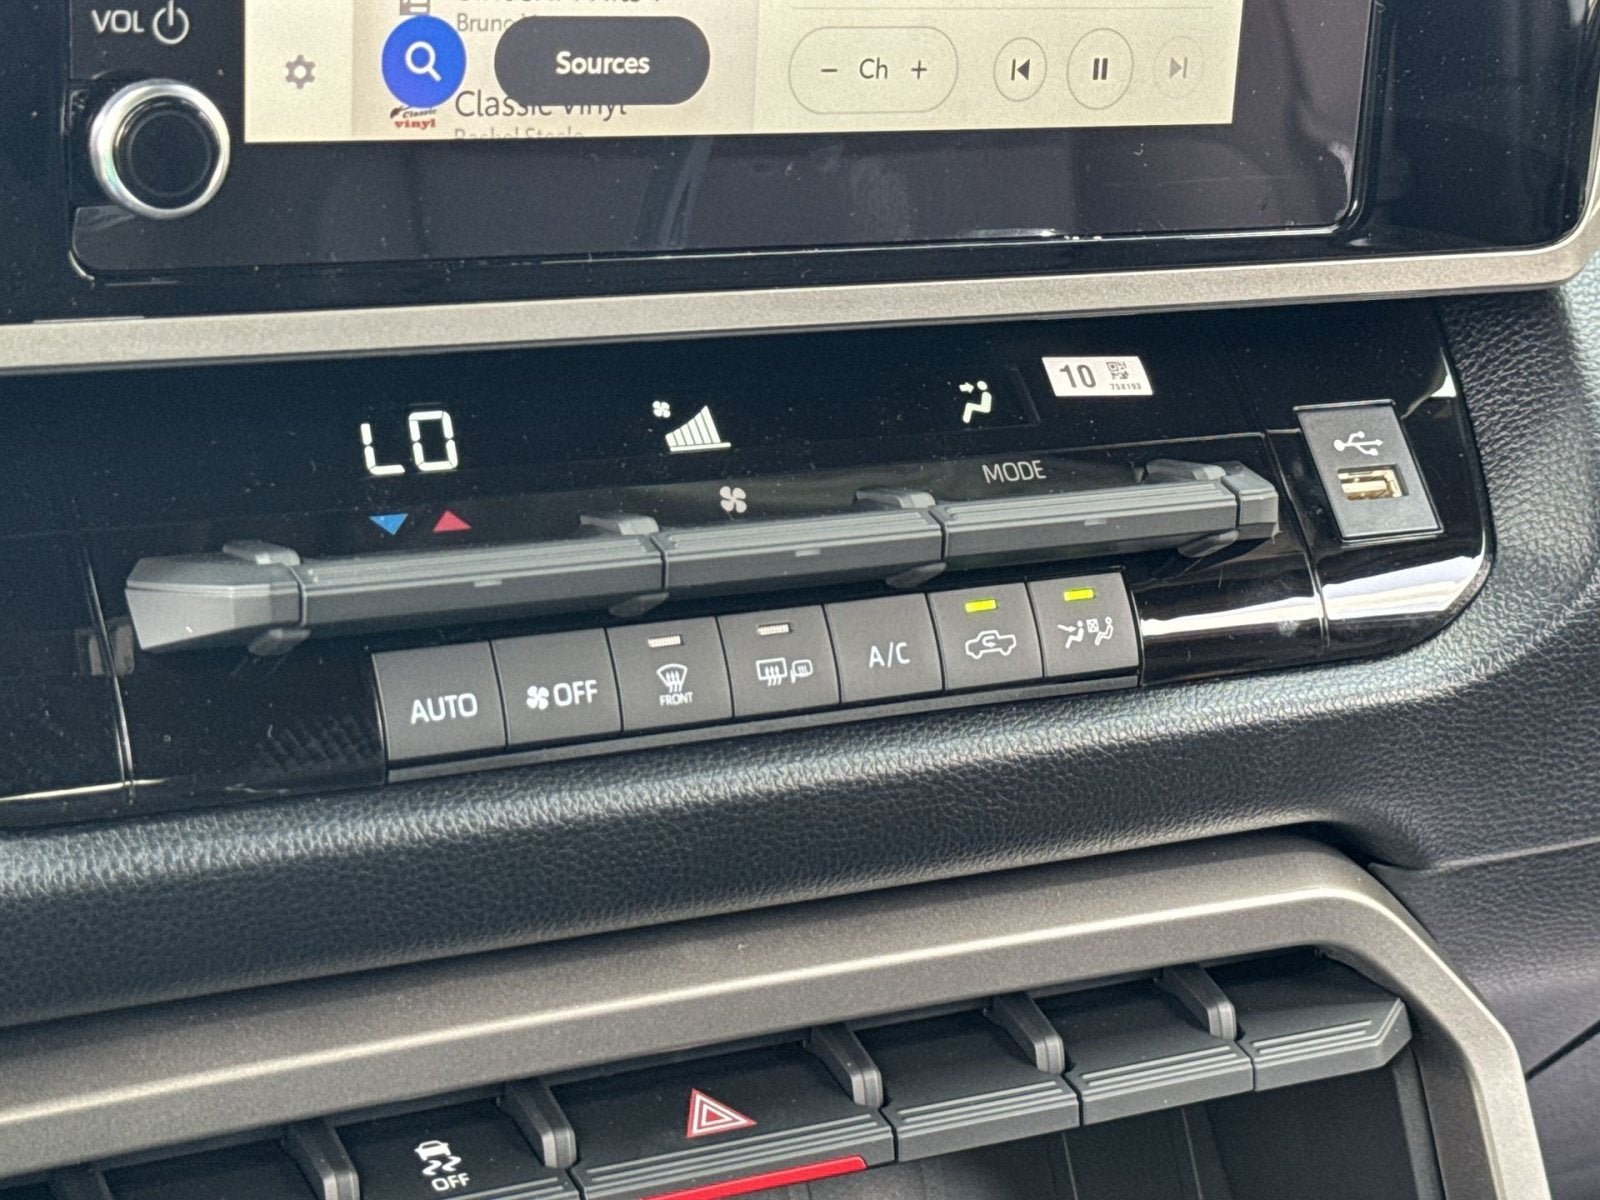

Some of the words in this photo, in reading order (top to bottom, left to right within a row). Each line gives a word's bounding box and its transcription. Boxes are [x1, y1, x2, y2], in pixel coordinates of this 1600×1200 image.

[91, 9, 145, 34] VOL
[555, 50, 651, 75] Sources
[859, 57, 888, 79] Ch
[394, 118, 437, 130] vinyl
[1059, 364, 1097, 388] 10
[360, 410, 459, 475] LO
[981, 459, 1047, 485] MODE
[868, 641, 911, 668] A/C
[553, 680, 598, 707] OFF
[659, 691, 693, 706] FRONT
[410, 693, 478, 724] AUTO
[431, 1173, 470, 1192] OFF
